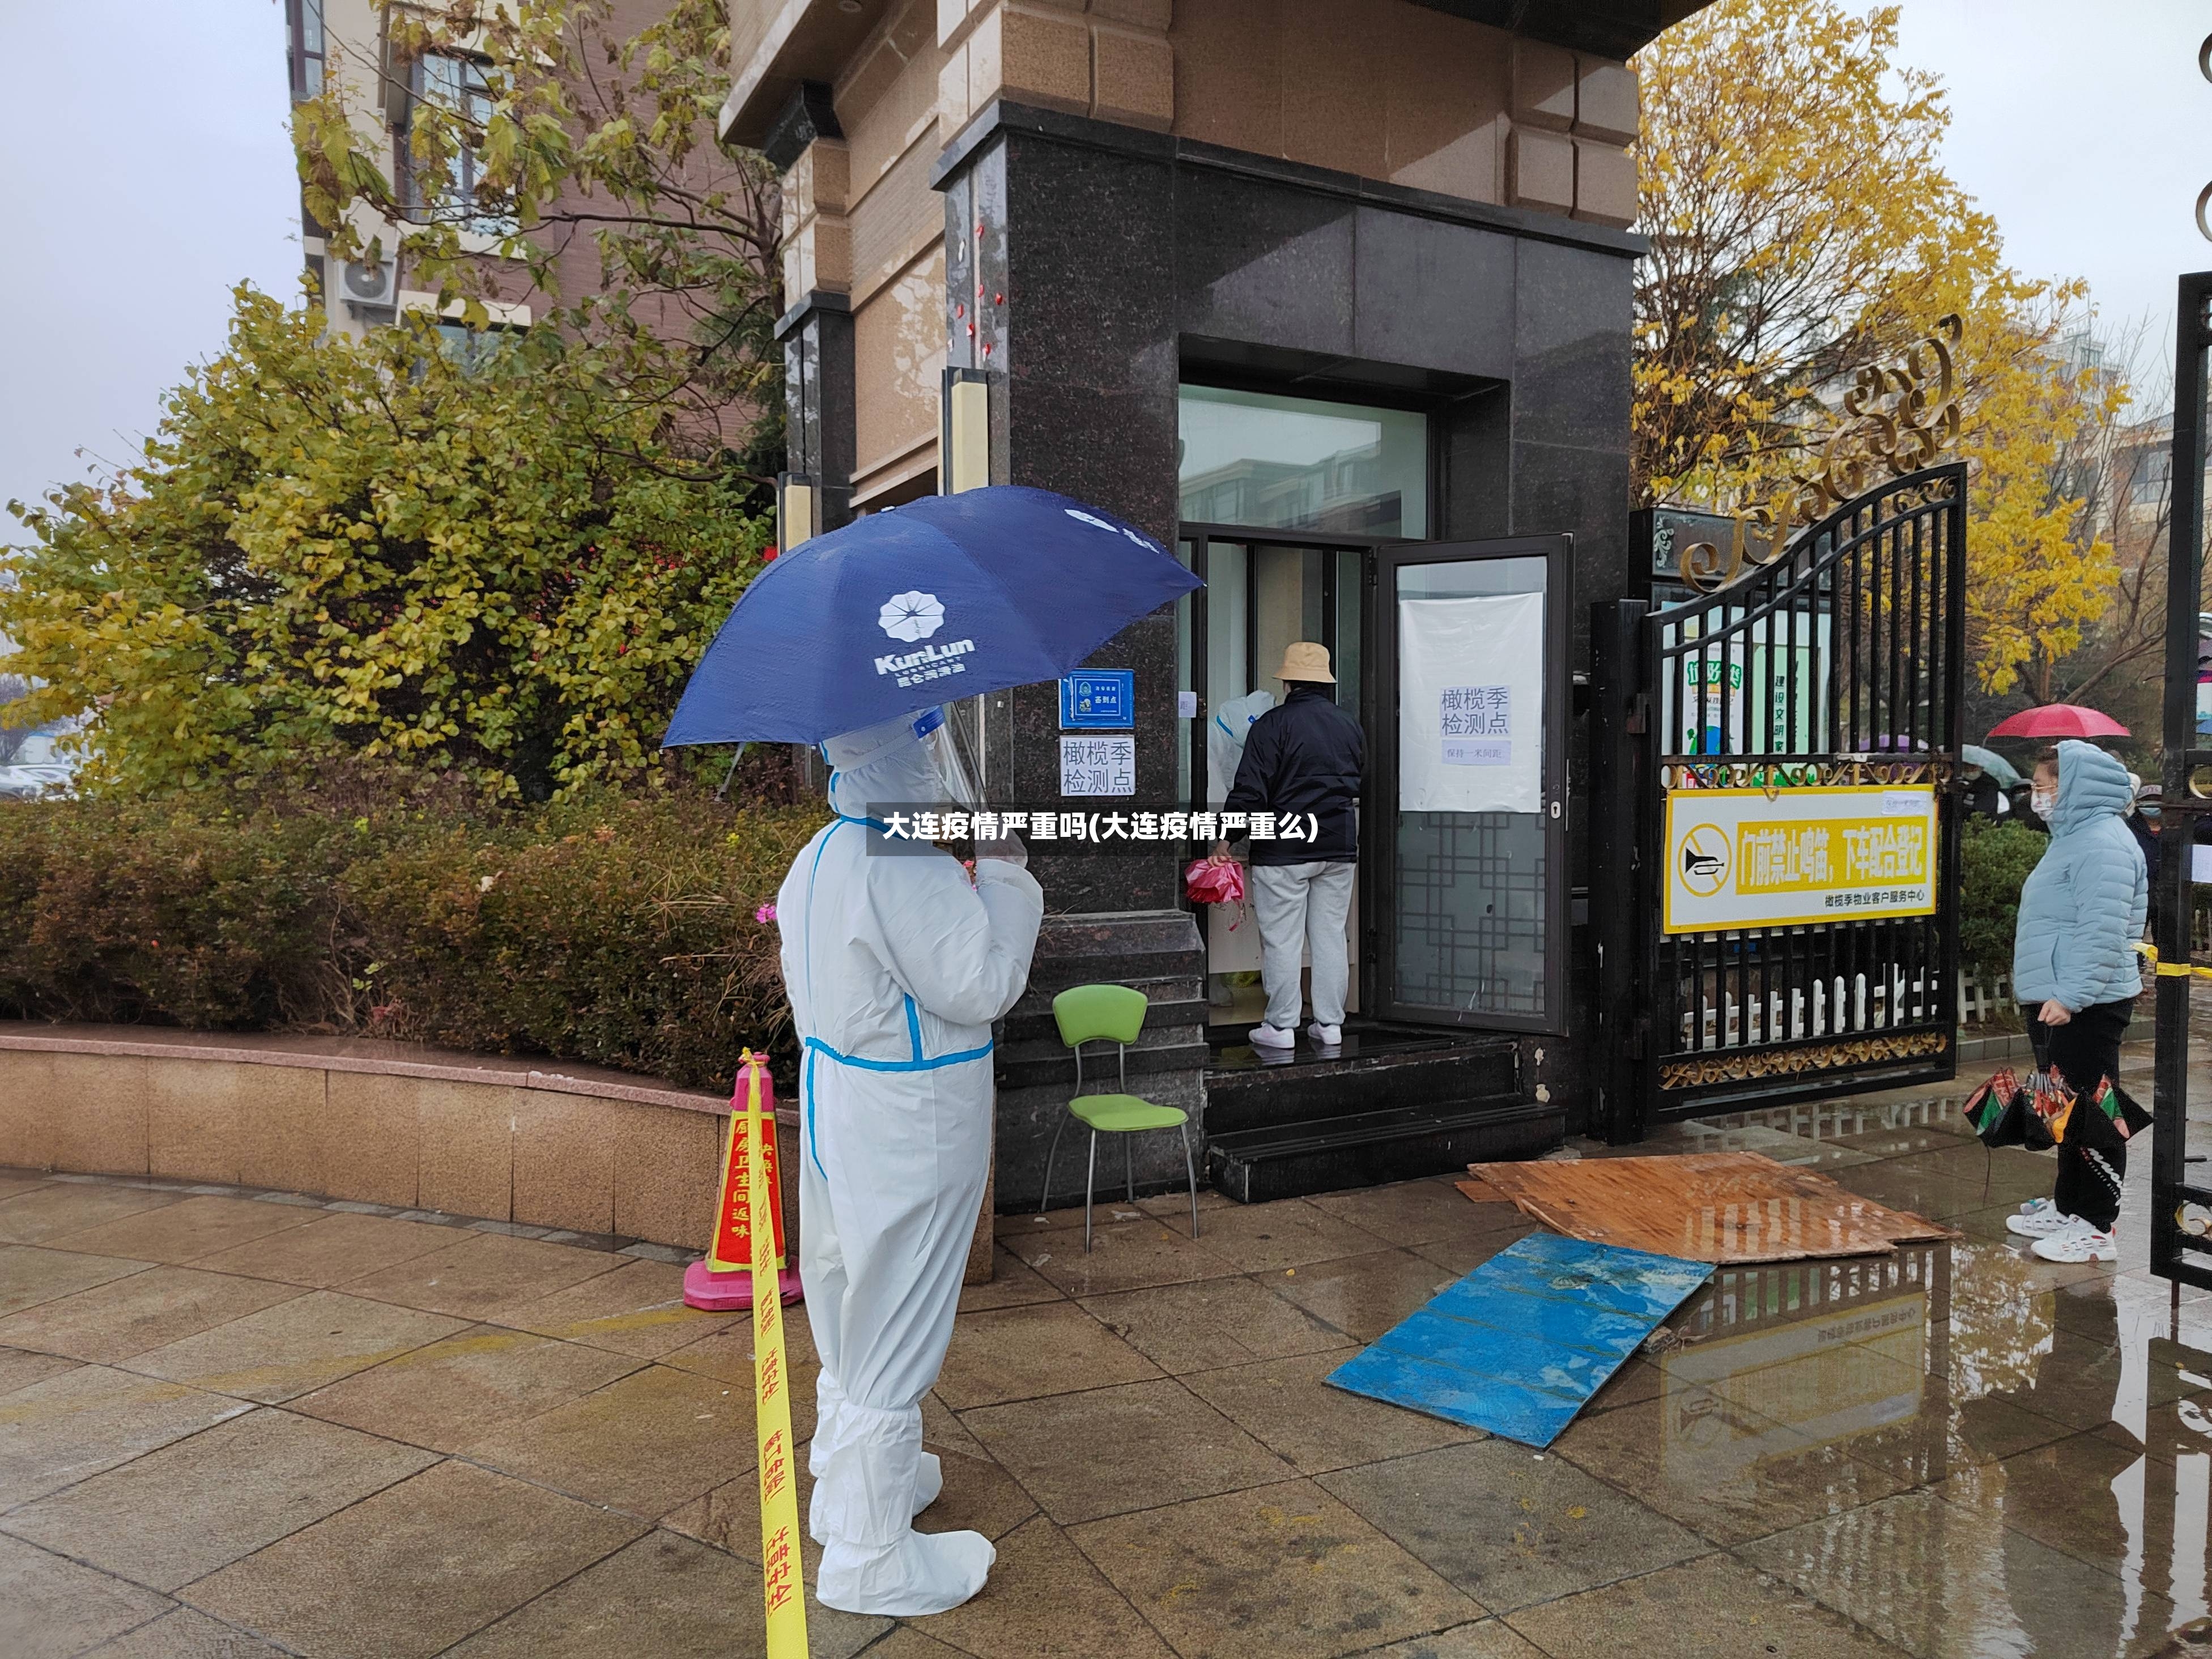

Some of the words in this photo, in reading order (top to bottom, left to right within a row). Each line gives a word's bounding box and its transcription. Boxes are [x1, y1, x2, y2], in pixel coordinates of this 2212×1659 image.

[874, 639, 975, 675] KunLun
[1441, 687, 1508, 711] 橄榄季
[1442, 712, 1508, 735] 检测点
[1064, 741, 1131, 766] 橄榄季
[1447, 748, 1503, 758] 保持一米间距
[1064, 768, 1131, 794] 检测点
[1825, 889, 1925, 907] 橄榄季物业客户服务中心
